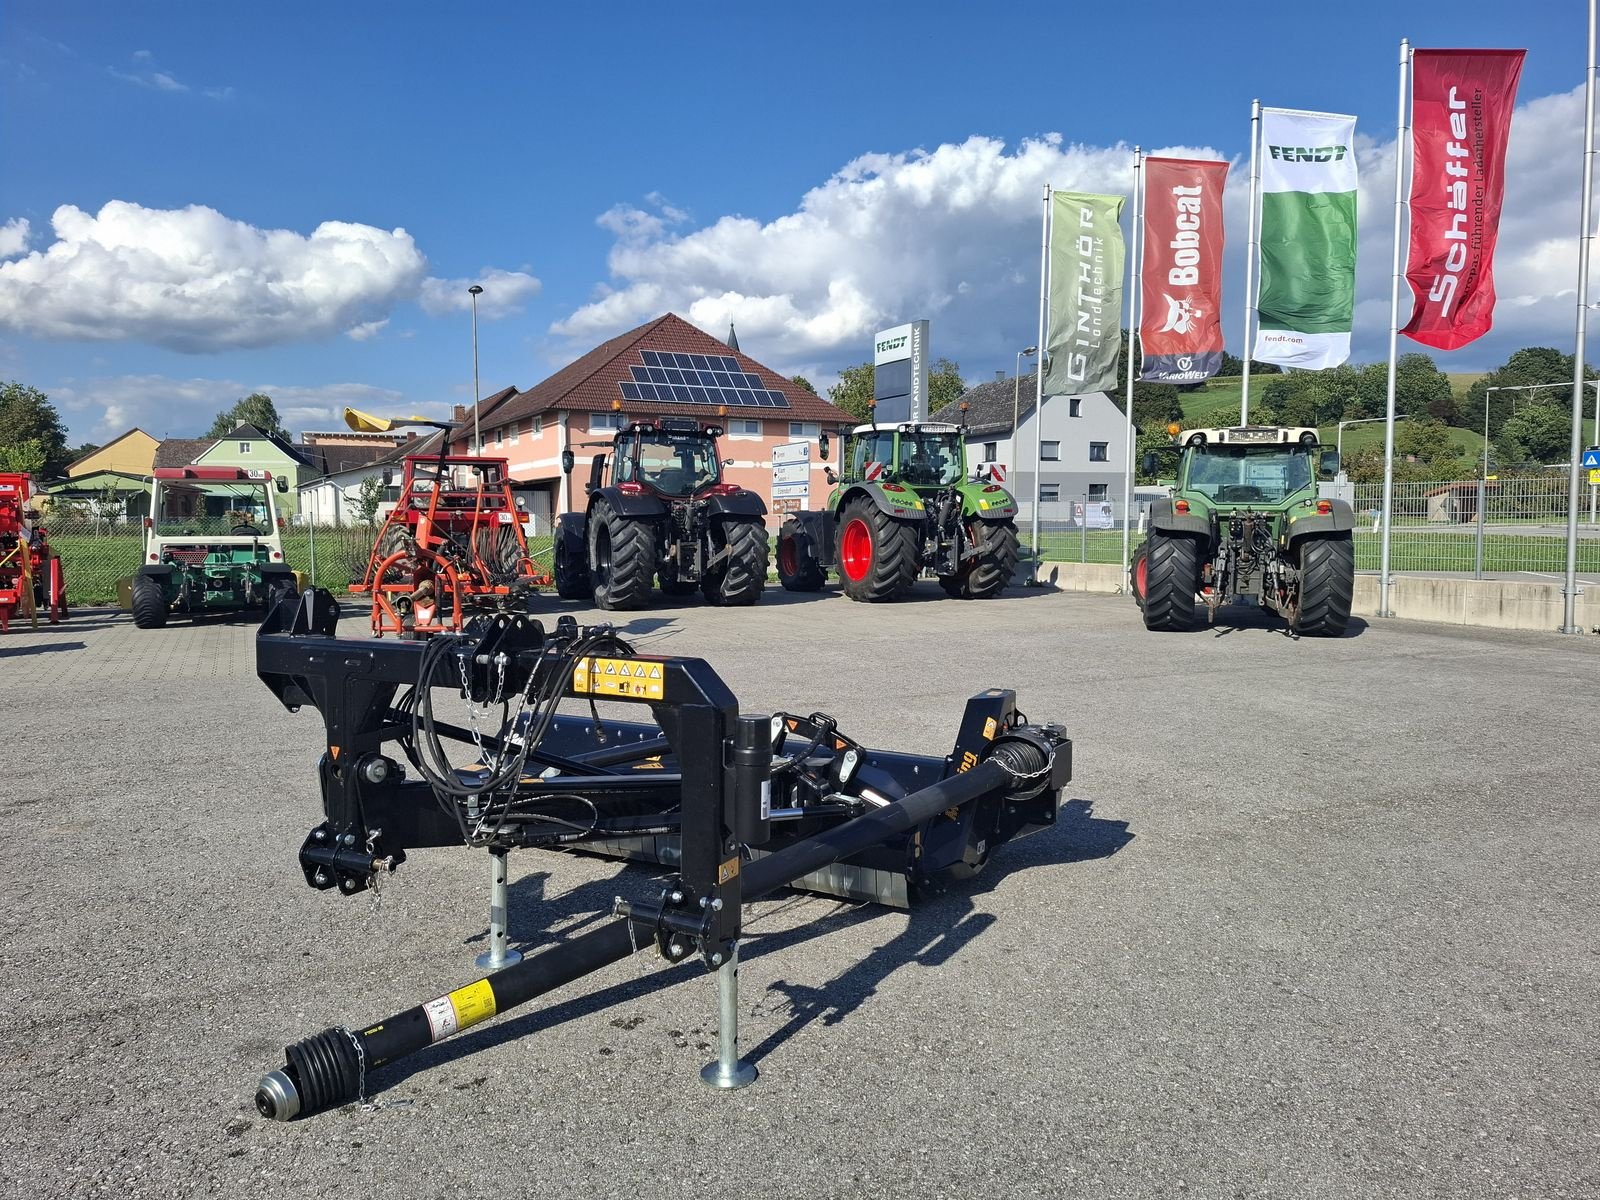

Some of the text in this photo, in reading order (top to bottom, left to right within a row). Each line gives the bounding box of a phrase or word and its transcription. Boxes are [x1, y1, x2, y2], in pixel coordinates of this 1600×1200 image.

[1269, 145, 1348, 162] FENDT
[1471, 87, 1484, 181] Laderhersteller
[1168, 185, 1202, 286] Bobcat
[1429, 86, 1468, 318] Schäffer
[1471, 185, 1484, 250] führender
[1067, 207, 1094, 381] GINTHÖR
[876, 336, 908, 353] FENDT
[913, 327, 921, 408] LANDTECHNIK
[1264, 335, 1304, 344] fendt.com
